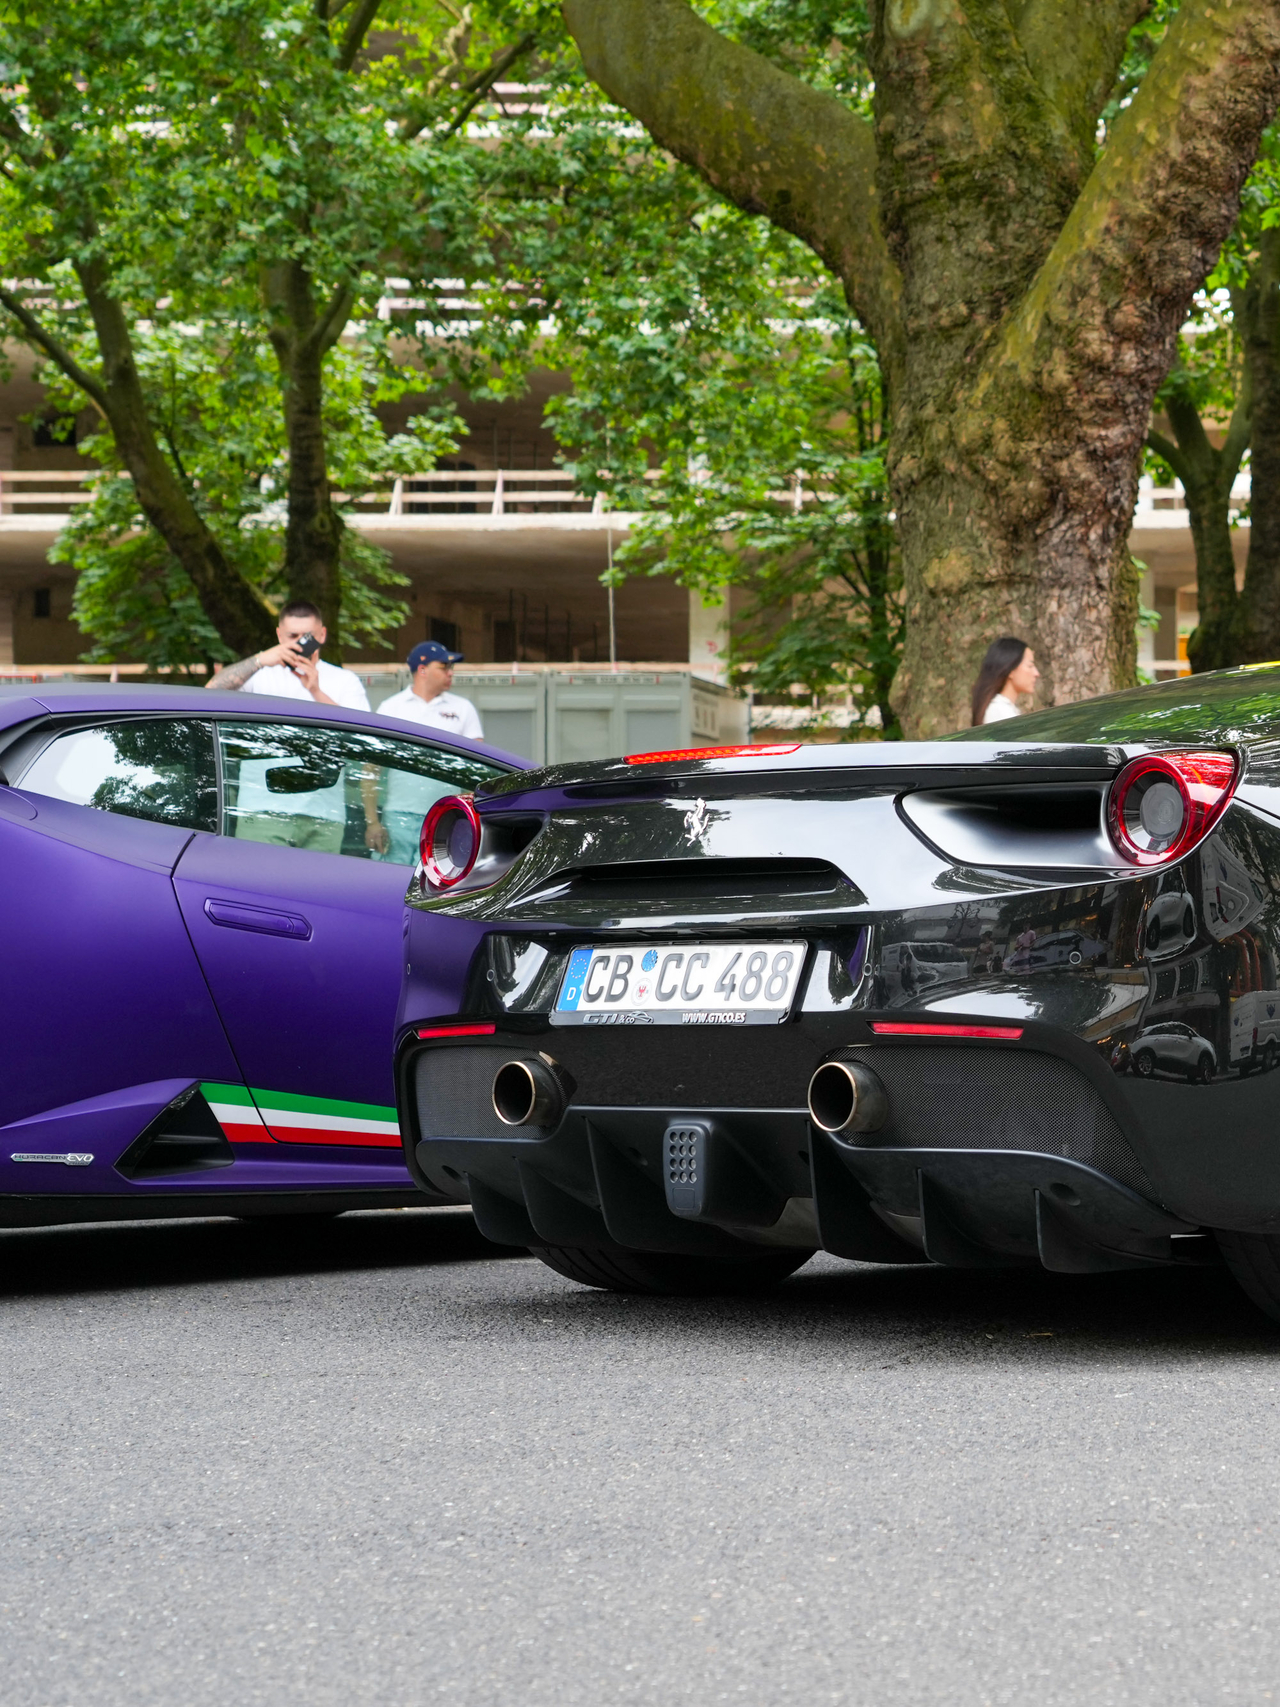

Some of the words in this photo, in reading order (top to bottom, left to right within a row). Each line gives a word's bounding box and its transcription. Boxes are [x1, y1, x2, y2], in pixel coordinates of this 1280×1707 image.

[566, 986, 577, 1001] D
[583, 955, 634, 1003] CB
[655, 952, 711, 1002] CC
[714, 950, 794, 1002] 488
